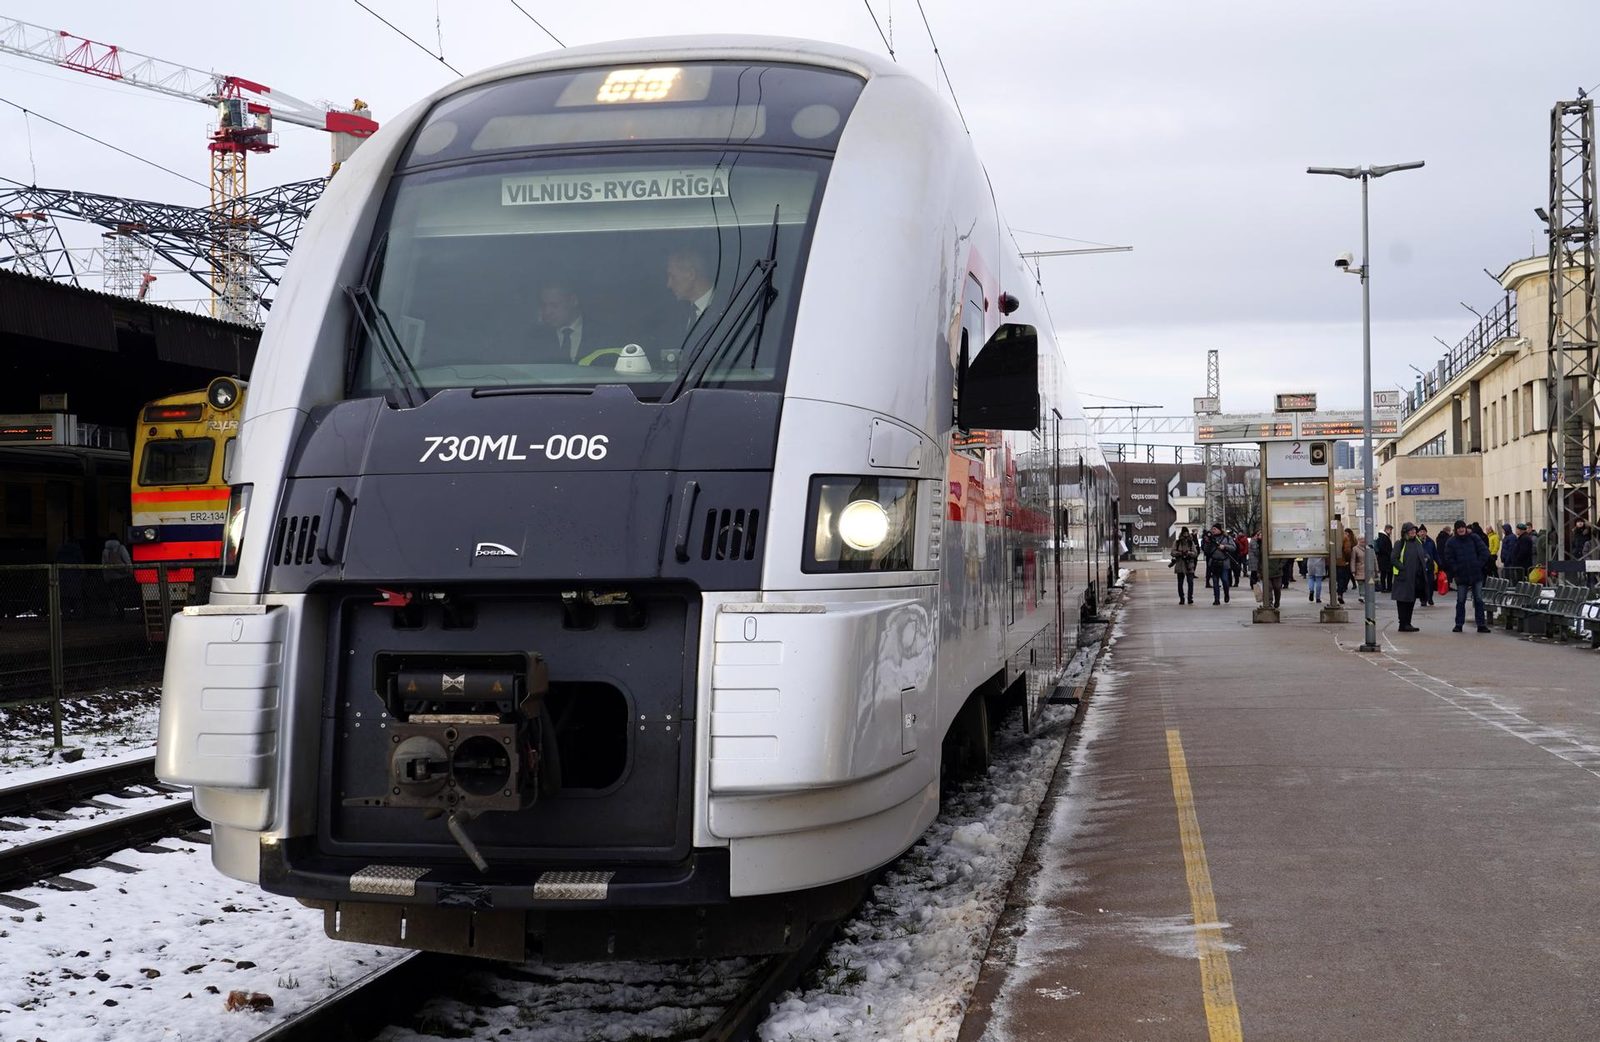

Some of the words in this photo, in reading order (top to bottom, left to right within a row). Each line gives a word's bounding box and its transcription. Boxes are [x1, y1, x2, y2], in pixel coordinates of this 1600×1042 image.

[506, 174, 726, 203] VILNIUS-RYGA/RĪGA
[1376, 394, 1387, 404] 10
[419, 434, 609, 463] 730ML-006
